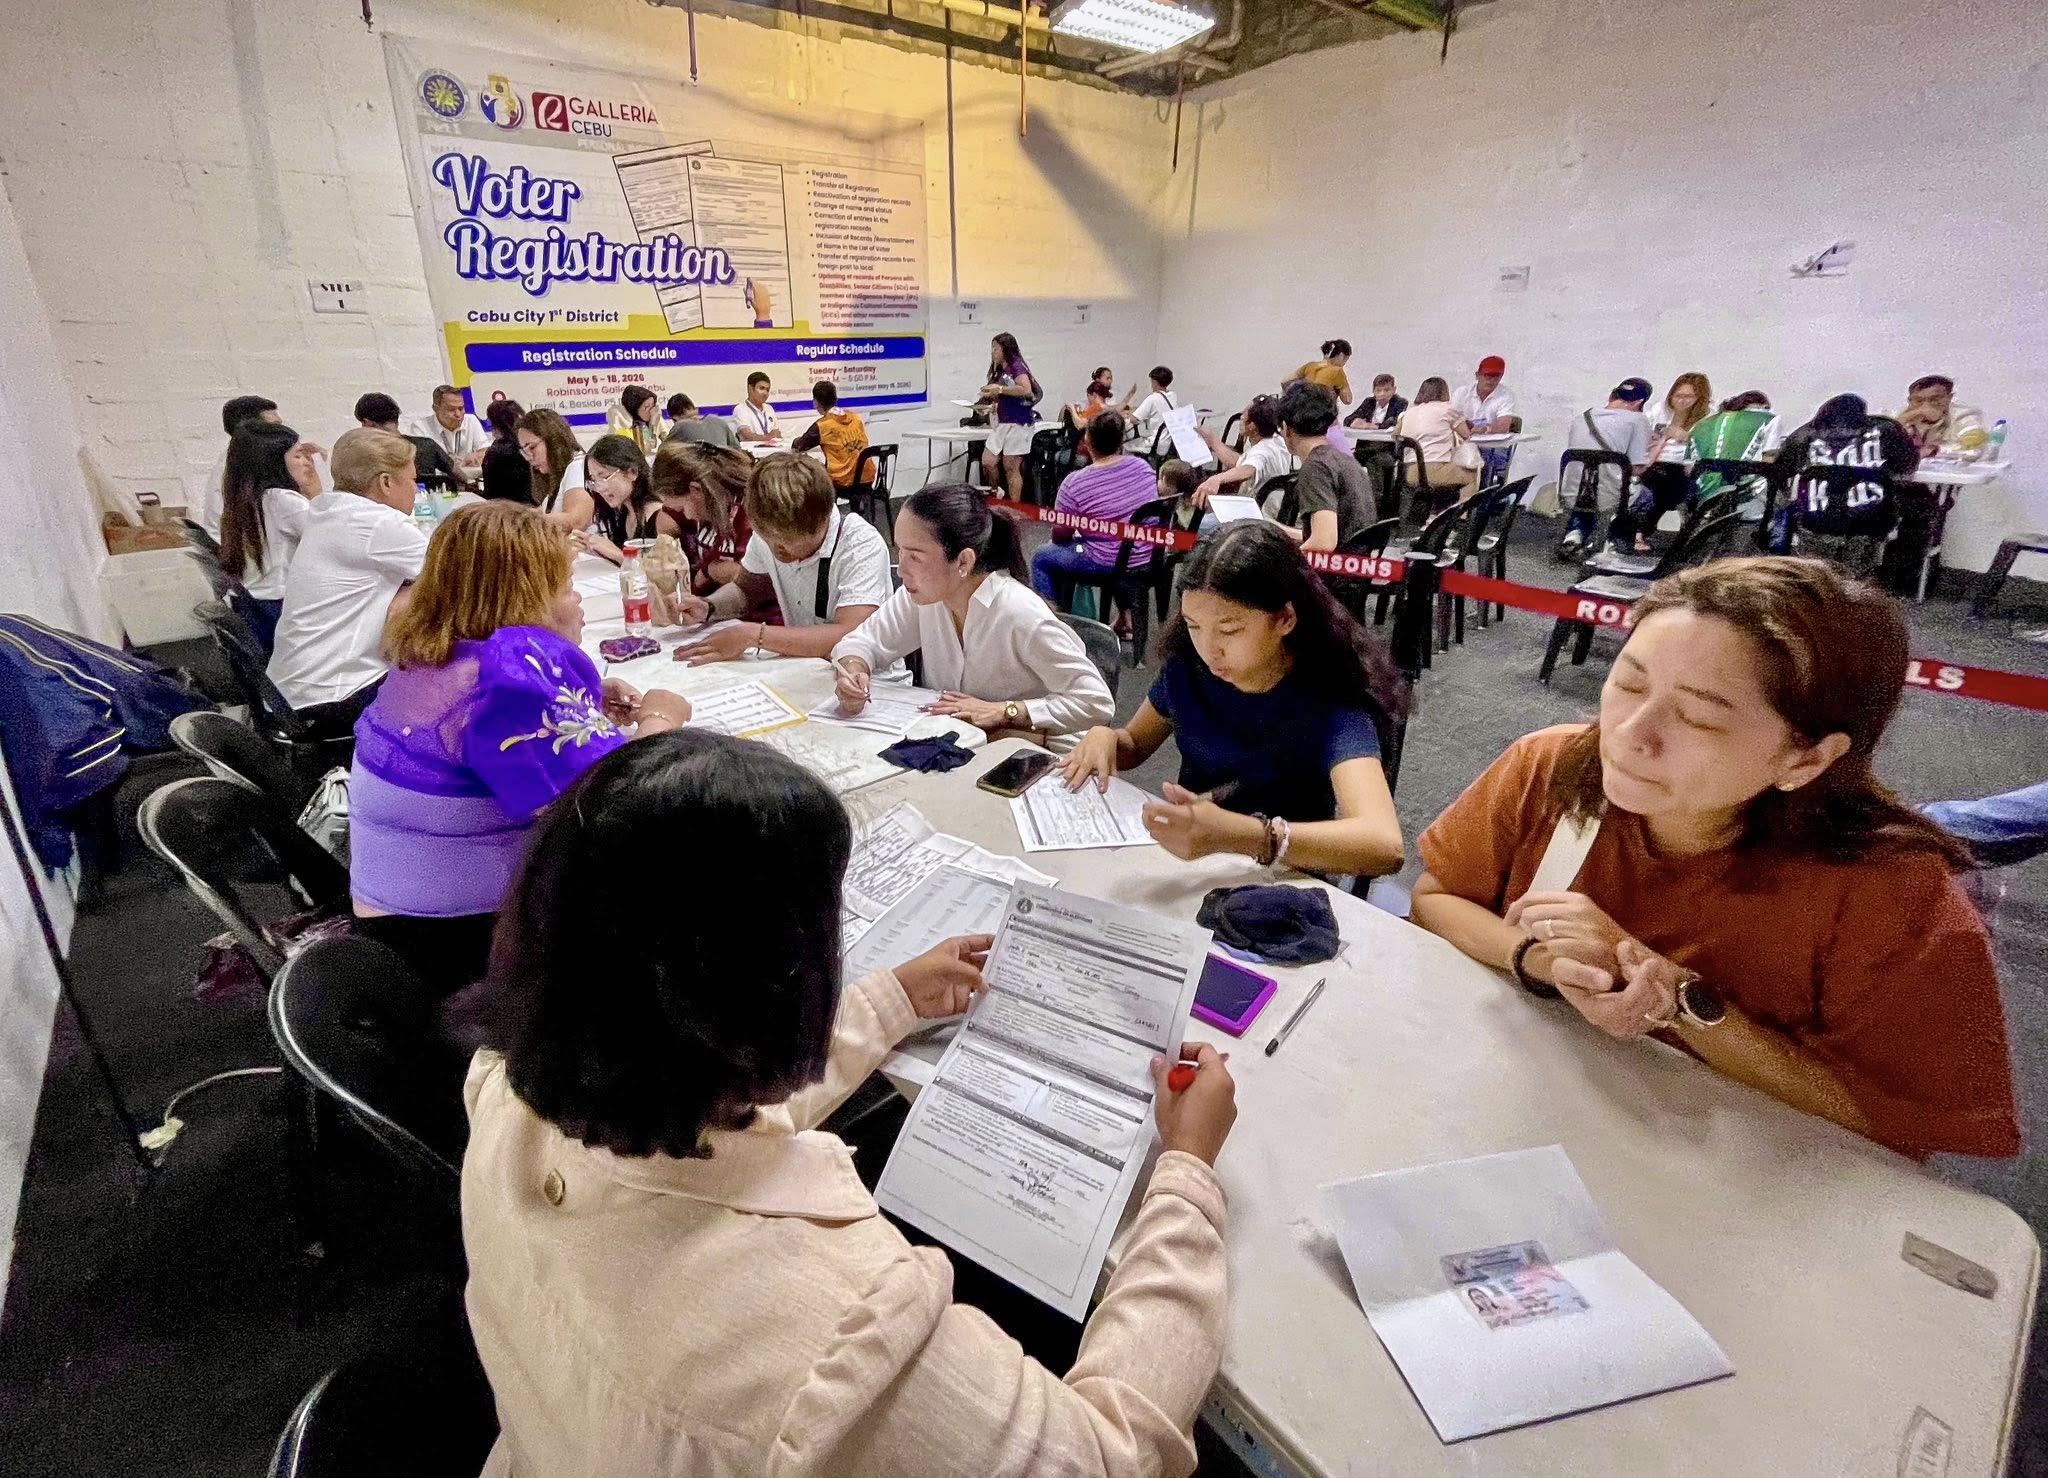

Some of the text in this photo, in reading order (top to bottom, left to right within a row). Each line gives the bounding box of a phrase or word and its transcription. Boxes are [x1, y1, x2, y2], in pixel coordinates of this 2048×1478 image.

[569, 97, 659, 125] GALLERIA
[571, 120, 612, 137] CEBU
[812, 170, 848, 179] Registration
[432, 153, 581, 221] Voter
[813, 180, 837, 189] Transfer
[814, 202, 837, 210] Change
[814, 211, 845, 221] Correction
[444, 218, 735, 296] Registration
[467, 309, 510, 323] Cebu
[513, 310, 546, 326] City
[566, 309, 619, 323] District
[522, 347, 677, 366] Registration Schedule
[796, 343, 885, 359] Regular Schedule
[843, 365, 877, 374] Saturday
[567, 376, 590, 386] May
[606, 374, 621, 384] 18,
[621, 374, 645, 382] 2026
[546, 386, 599, 397] Robinsons
[601, 385, 624, 395] Galle
[569, 400, 602, 409] Beside
[1039, 508, 1175, 546] ROBINSONS MALLS
[1306, 551, 1392, 578] INSONS
[1576, 599, 1634, 629] RO
